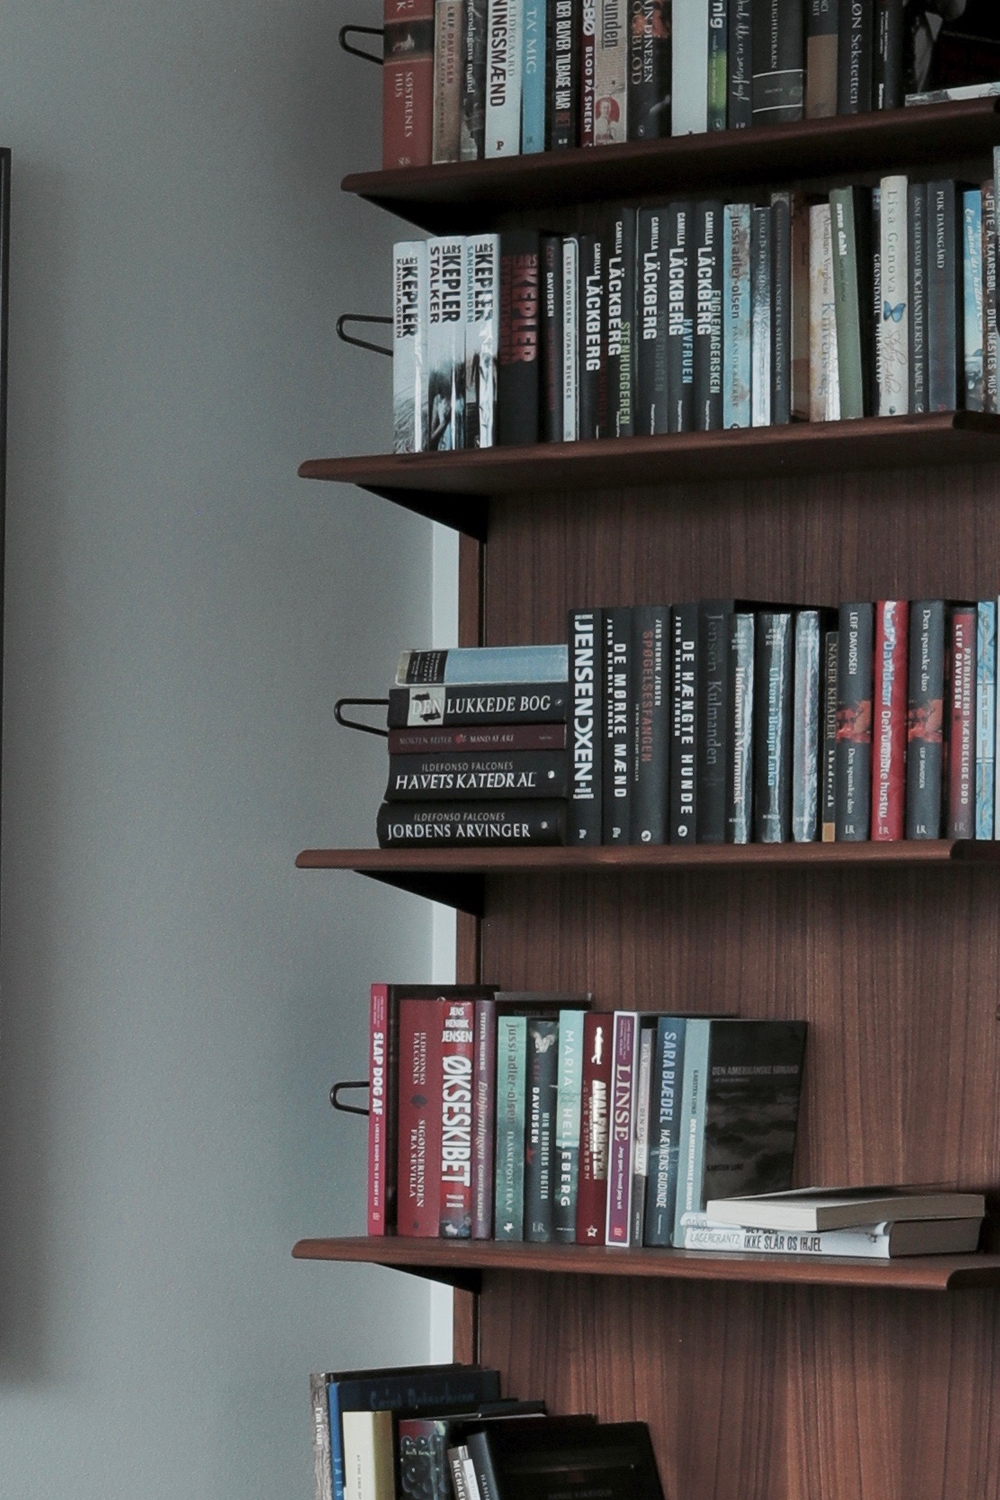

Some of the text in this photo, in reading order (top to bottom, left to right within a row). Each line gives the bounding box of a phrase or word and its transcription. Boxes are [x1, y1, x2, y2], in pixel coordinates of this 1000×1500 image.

[394, 73, 403, 99] HUS
[525, 39, 536, 74] MIG
[555, 21, 571, 110] BLIVER TILBAGE HAR
[584, 46, 593, 132] BLOD SNEEN
[643, 24, 653, 83] DINESEN
[850, 34, 862, 104] Sekstetten
[651, 216, 659, 251] CAMILLA
[677, 211, 686, 246] CAMILLA
[705, 211, 713, 246] CAMILLA
[836, 203, 844, 228] arne
[936, 190, 944, 211] PUK
[442, 244, 461, 254] LARS
[475, 243, 494, 253] LARS
[837, 231, 847, 256] dahl
[886, 190, 898, 294] Lisa Genova
[985, 192, 997, 295] JETTE KAARSBØL
[401, 266, 418, 338] KEPLER
[430, 246, 440, 324] STALKER
[441, 255, 460, 323] KEPLER
[466, 245, 474, 324] SANDMANDEN
[475, 253, 493, 323] KEPLER
[608, 257, 625, 356] LÄCKBERG
[643, 252, 660, 340] LÄCKBERG
[669, 247, 687, 336] LÄCKBERG
[697, 246, 715, 335] LÄCKBERG
[730, 247, 743, 318] adler-olsen
[586, 275, 602, 371] LÄCKBERG
[682, 318, 693, 383] HAVFRUEN
[709, 289, 720, 394] ENGLEMAGERSKEN
[620, 321, 630, 424] STENHUGGEREN
[986, 376, 997, 395] HUS
[574, 621, 594, 716] JENSEN
[920, 609, 931, 692] Den spanske duo
[954, 624, 963, 709] LEIF DAVIDSEN
[446, 695, 552, 714] LUKKEDE BOG
[613, 643, 627, 798] DE MØRKE MÆND
[641, 630, 653, 762] SPØGELSESFANGEN
[826, 642, 837, 740] NASER KHADER
[847, 611, 859, 762] LEIF DAVIDSEN Den
[961, 647, 971, 779] PATRIARKENS HÆNDELIGE
[680, 641, 695, 815] DE HÆNGTE HUNDE
[706, 680, 724, 765] Kulmanden
[395, 772, 537, 790] HAVETS KATEDRAL
[422, 761, 514, 772] ILDEFONSO FALCONES
[387, 824, 531, 840] JORDENS ARVINGER
[372, 1031, 384, 1066] SLAP
[506, 1023, 518, 1053] jussi
[372, 1067, 384, 1096] DOG
[372, 1097, 384, 1116] AF
[614, 1063, 631, 1143] LINSE
[659, 1031, 678, 1124] SARA BLÆDEL
[441, 1054, 472, 1187] ØKSESKIBET
[530, 1086, 540, 1144] DAVIDSEN
[540, 1130, 550, 1166] BRODERS
[559, 1029, 576, 1207] MARIA HELLEBERG
[744, 1235, 763, 1251] IKKE
